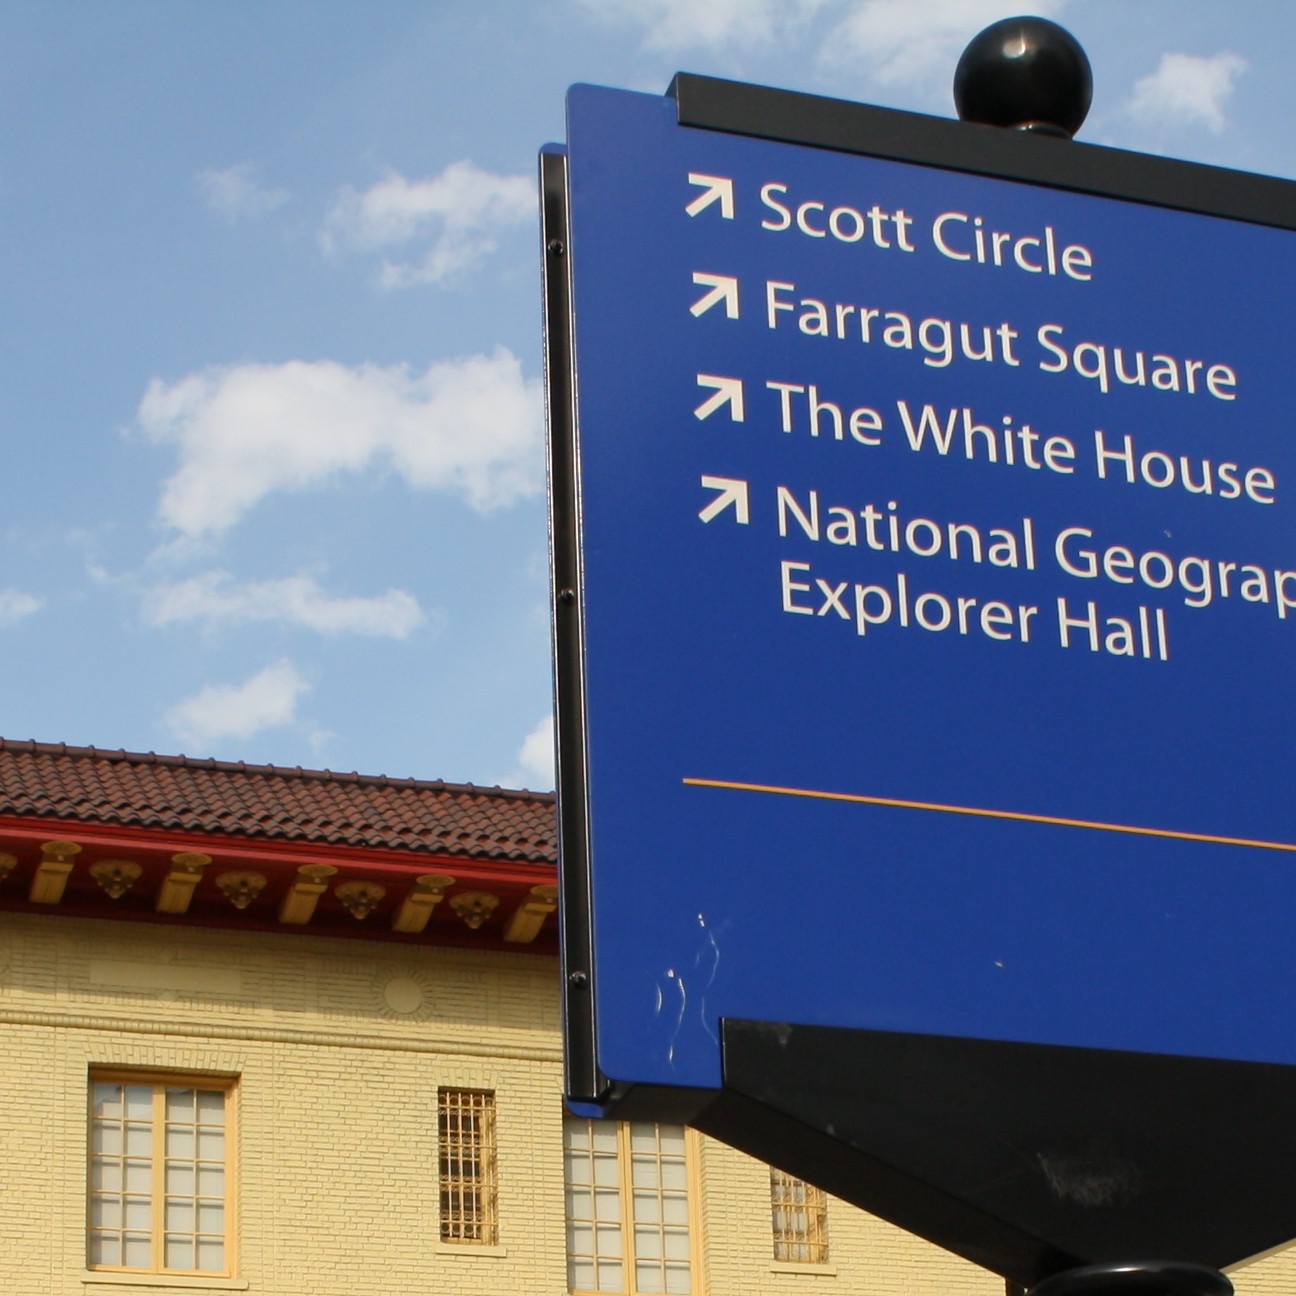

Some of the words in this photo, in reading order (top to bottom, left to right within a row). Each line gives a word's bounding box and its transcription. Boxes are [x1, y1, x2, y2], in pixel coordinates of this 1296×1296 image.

[760, 181, 915, 252] Scott
[932, 211, 1092, 281] Circle
[766, 279, 1020, 368] Farragut
[1037, 323, 1236, 400] Square
[765, 380, 883, 446] The
[896, 400, 1075, 474] White
[1094, 430, 1275, 504] House
[777, 486, 1035, 570] National
[780, 560, 1038, 642] Explorer
[1057, 597, 1168, 661] Hall
